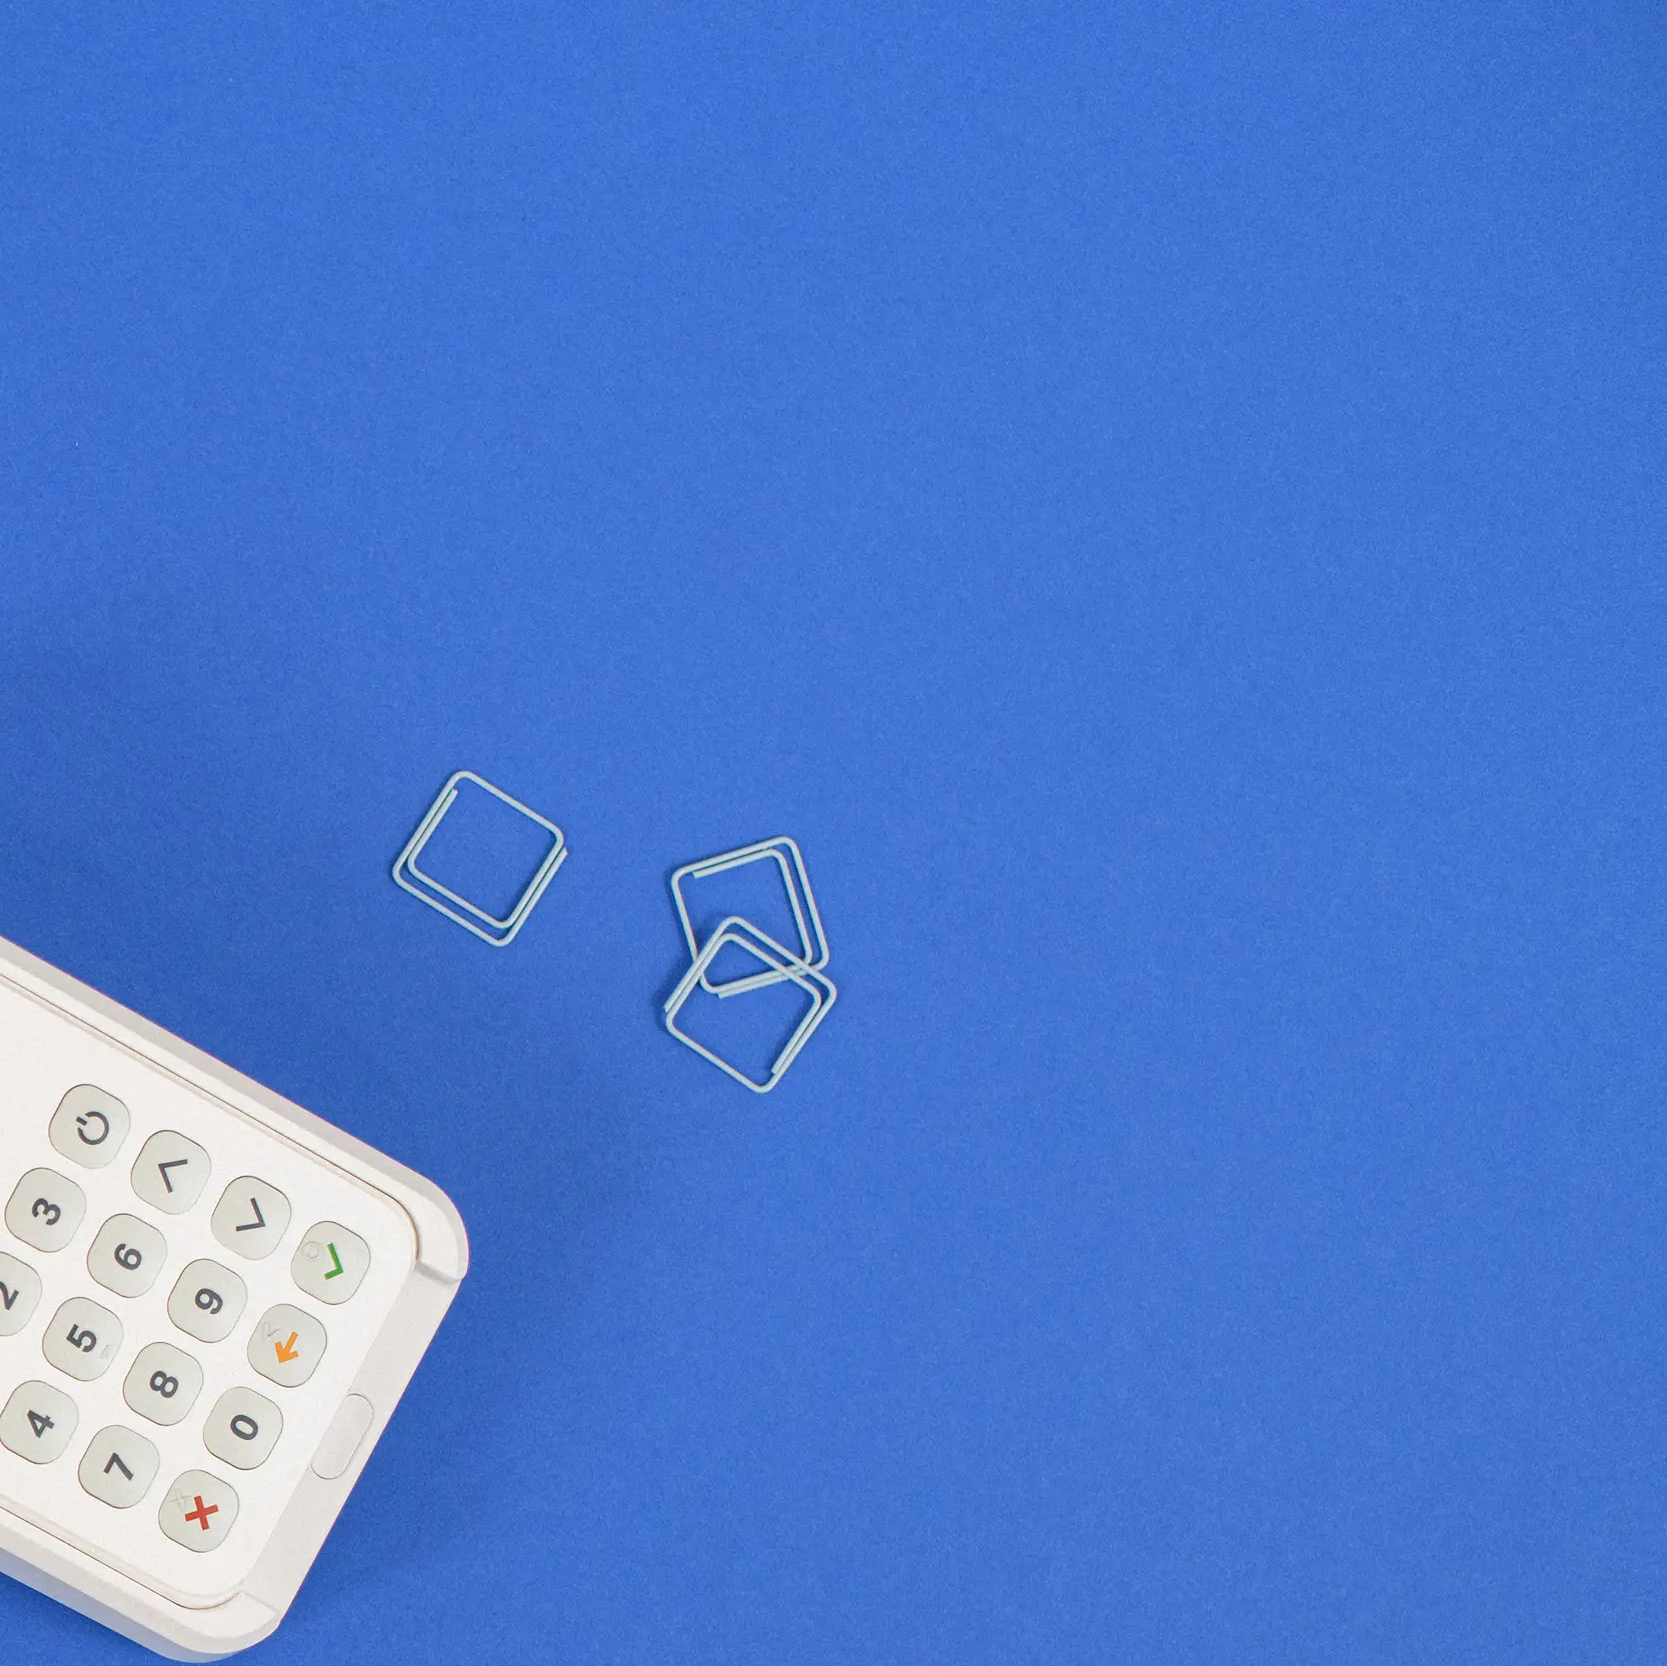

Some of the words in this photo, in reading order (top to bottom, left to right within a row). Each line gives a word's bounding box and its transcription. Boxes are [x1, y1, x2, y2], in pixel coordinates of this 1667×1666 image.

[30, 1196, 62, 1227] 3
[25, 1408, 56, 1440] 4
[65, 1322, 98, 1354] 5
[113, 1242, 143, 1272] 6
[102, 1451, 135, 1482] 7
[148, 1369, 180, 1400] 8
[193, 1287, 224, 1316] 9
[229, 1413, 260, 1442] 0
